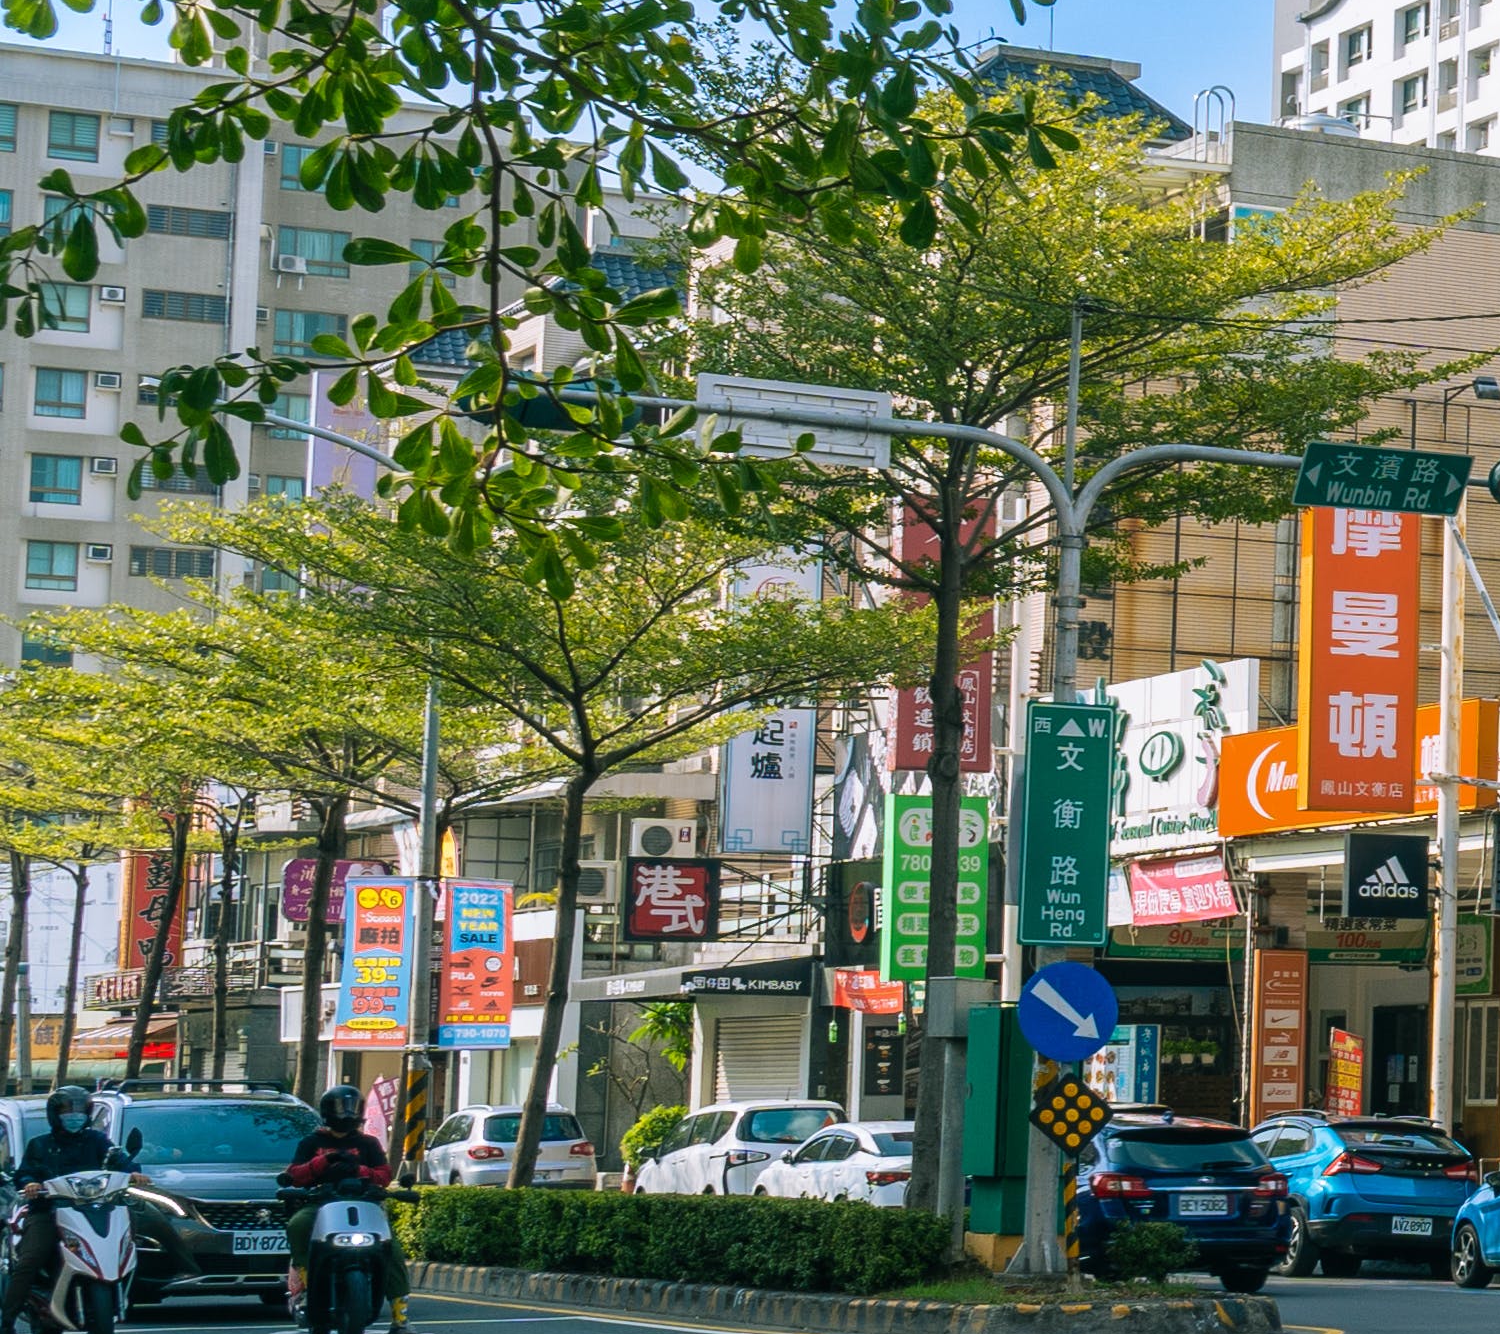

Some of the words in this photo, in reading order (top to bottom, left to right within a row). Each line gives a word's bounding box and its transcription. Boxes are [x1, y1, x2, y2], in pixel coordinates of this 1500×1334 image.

[1332, 451, 1441, 485] 文濱路
[1326, 480, 1391, 507] Wunbin
[1403, 486, 1432, 509] Rd.
[1330, 508, 1400, 759] 摩曼頓
[1034, 717, 1052, 735] 西
[1320, 779, 1404, 799] 鳳山文衡店
[1052, 743, 1084, 887] 文衡路
[458, 892, 498, 905] 2022
[1046, 888, 1080, 905] Wun
[1358, 882, 1419, 899] adidas
[634, 864, 706, 936] 港式
[1041, 906, 1085, 925] Heng
[459, 921, 499, 932] YEAR
[1050, 923, 1076, 938] Rd.
[459, 933, 497, 944] SALE
[450, 972, 476, 980] FILA
[748, 980, 802, 991] KIMBABY
